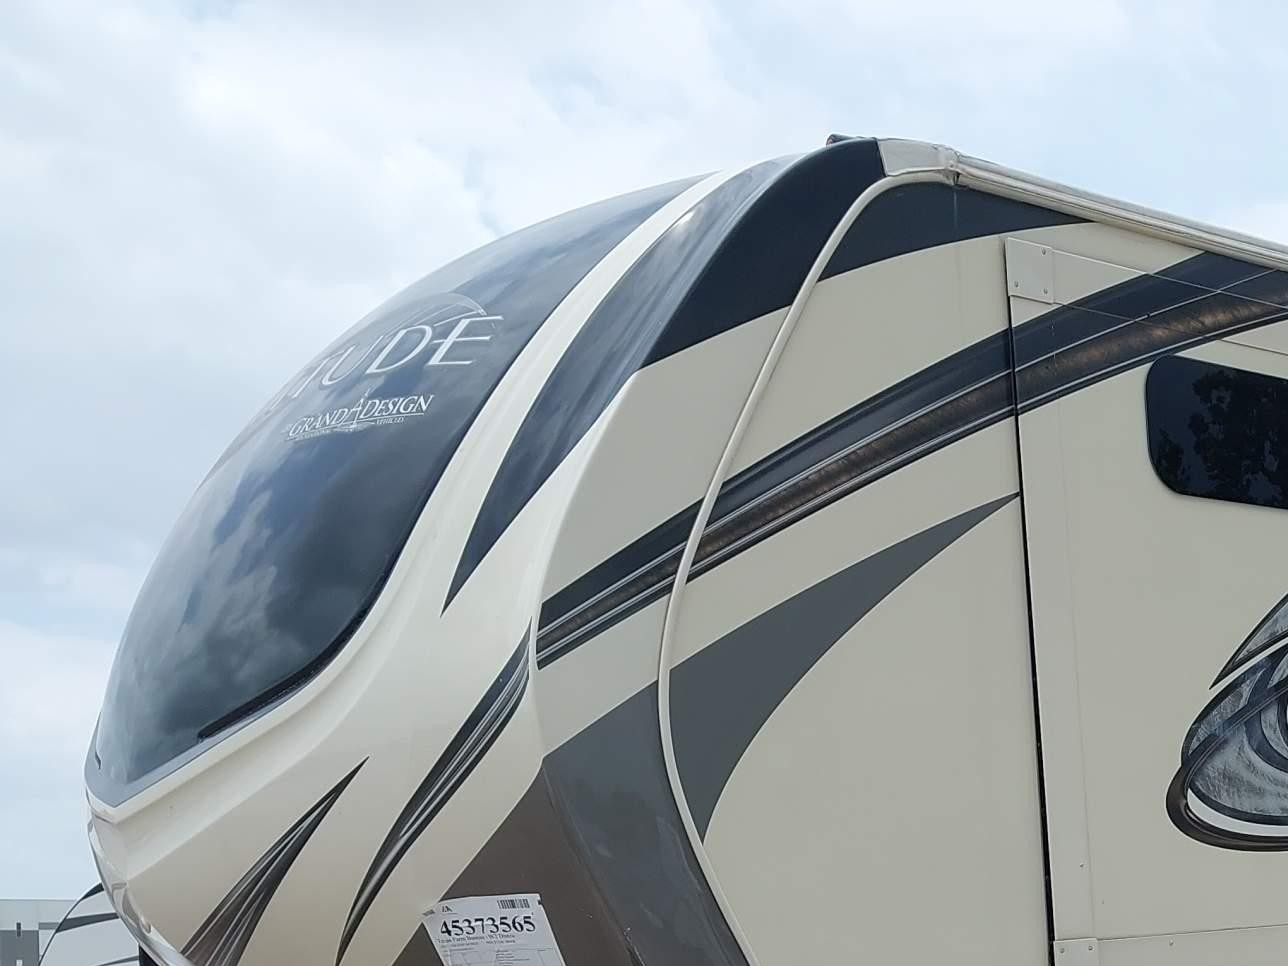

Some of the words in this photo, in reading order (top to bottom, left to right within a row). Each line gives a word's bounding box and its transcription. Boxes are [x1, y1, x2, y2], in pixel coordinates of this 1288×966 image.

[288, 408, 352, 437] GRAND
[360, 395, 435, 419] DESIGN
[440, 915, 536, 937] 45373565
